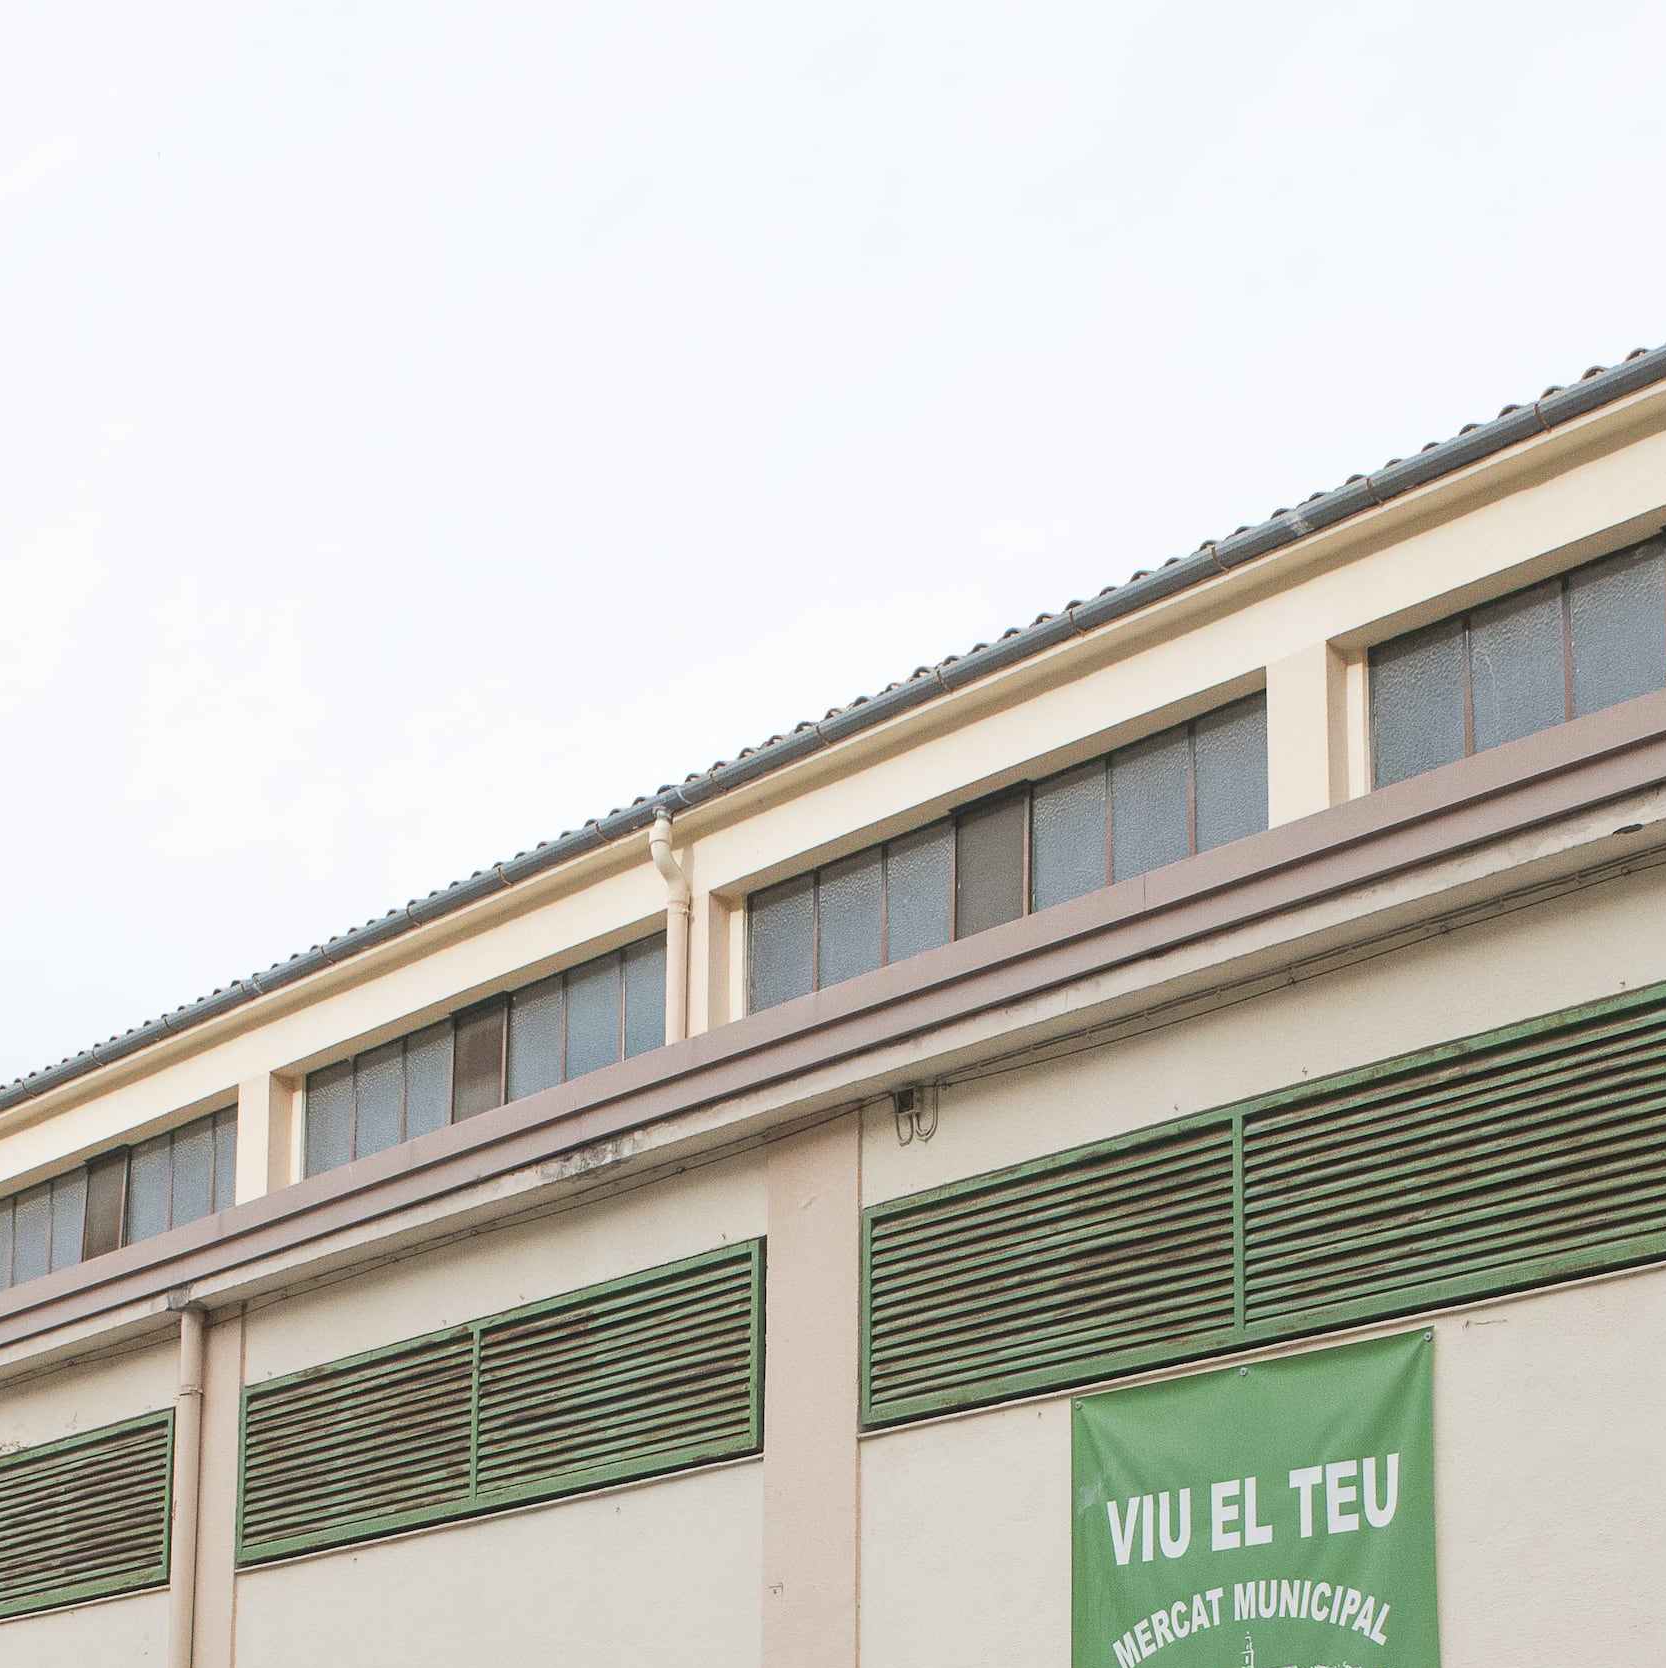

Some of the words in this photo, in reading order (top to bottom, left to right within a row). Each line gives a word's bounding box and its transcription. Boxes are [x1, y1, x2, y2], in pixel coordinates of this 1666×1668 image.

[1107, 1485, 1192, 1566] VIU
[1210, 1476, 1273, 1552] EL
[1288, 1453, 1401, 1539] TEU
[1233, 1579, 1392, 1646] MUNICIPAL
